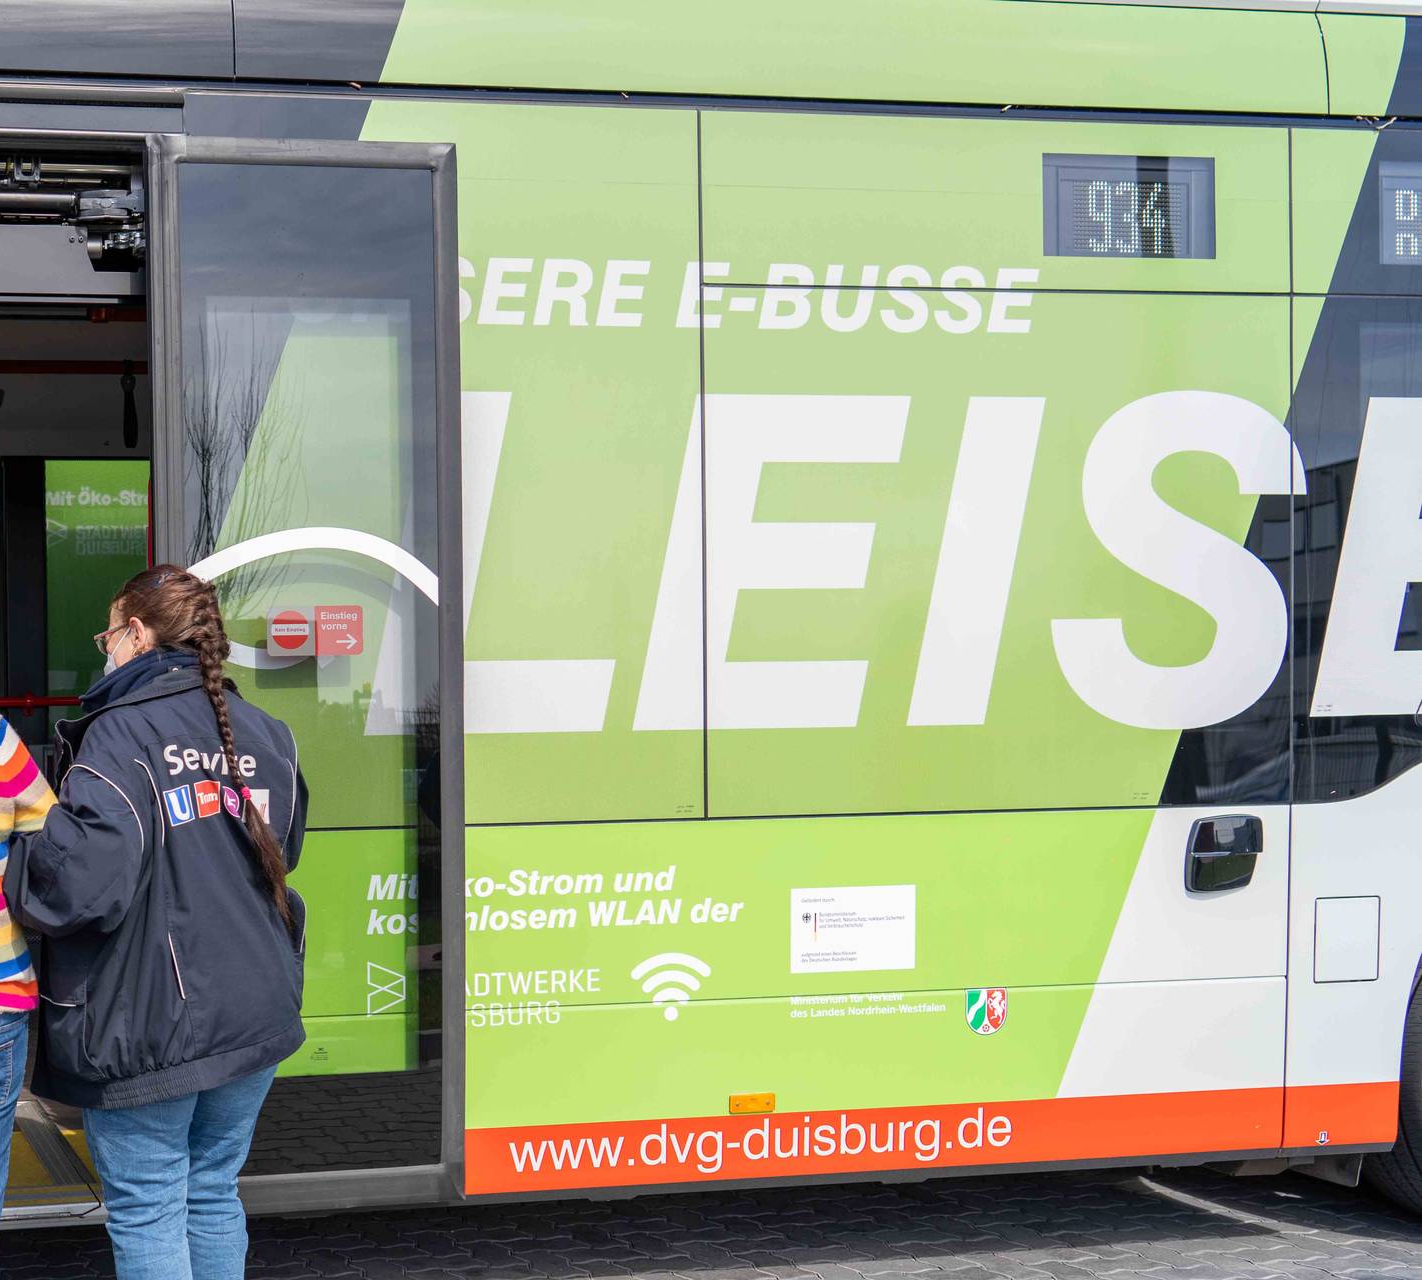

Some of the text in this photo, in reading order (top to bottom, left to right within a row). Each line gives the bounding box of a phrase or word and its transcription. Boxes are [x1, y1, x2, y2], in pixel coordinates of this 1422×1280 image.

[1088, 180, 1165, 254] 934
[675, 261, 1040, 334] E-BUSSE
[320, 611, 358, 621] Einstieg
[321, 622, 348, 631] vorne
[366, 873, 419, 901] Mit
[613, 865, 677, 893] und
[588, 898, 683, 928] WLAN
[690, 897, 745, 924] der
[790, 1003, 946, 1018] des Landes Nordrhein-Westfalen
[509, 1106, 1013, 1174] www.dvg-duisburg.de
